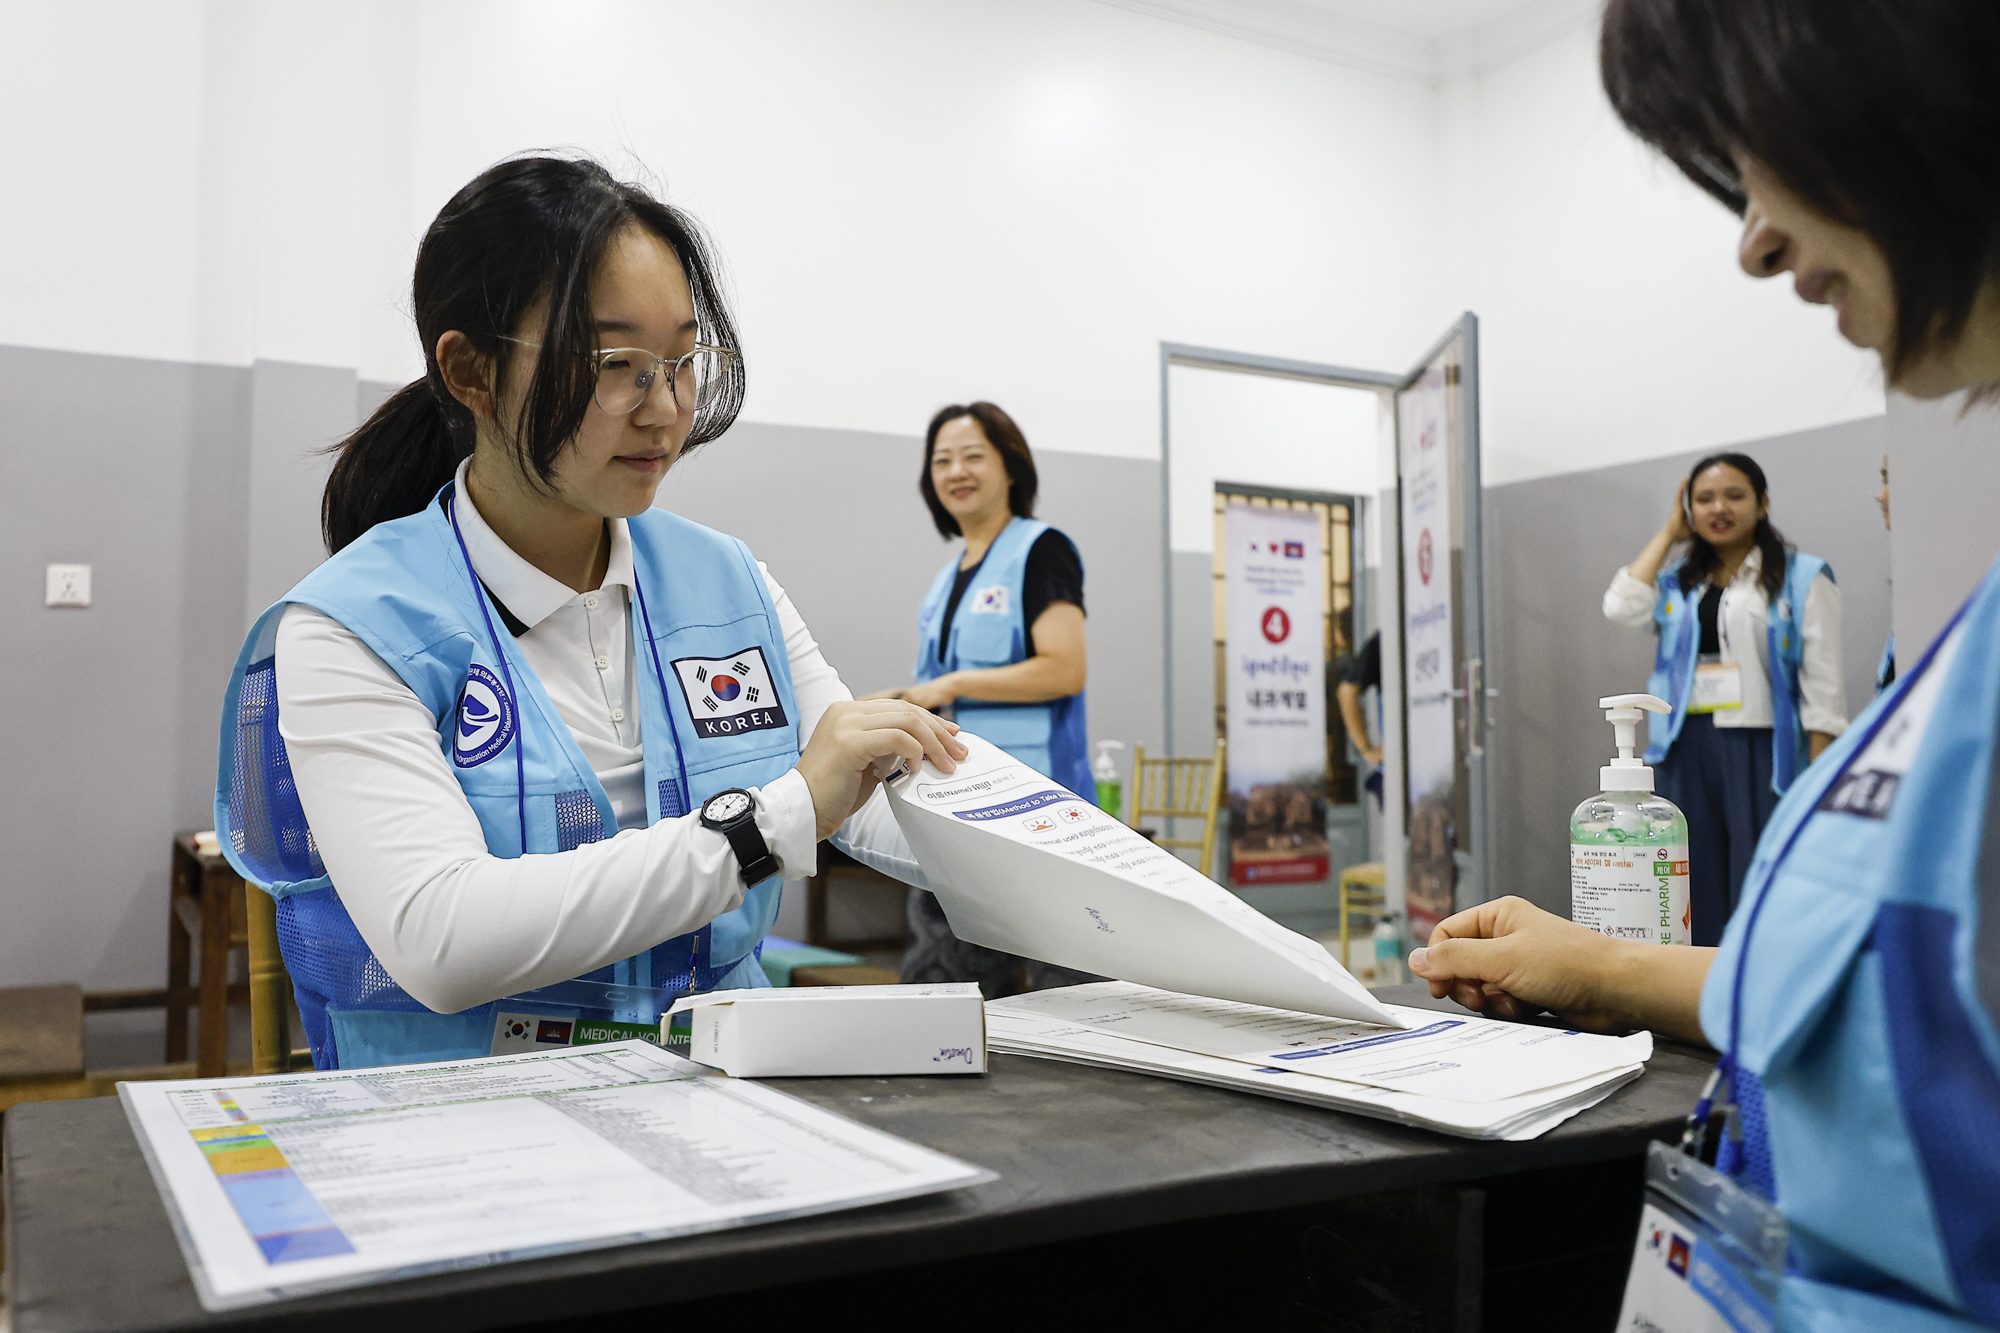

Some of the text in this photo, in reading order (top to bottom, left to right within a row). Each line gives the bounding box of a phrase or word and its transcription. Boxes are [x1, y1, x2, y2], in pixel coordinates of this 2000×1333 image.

[1266, 610, 1283, 640] 4
[705, 711, 774, 733] KOREA
[488, 731, 508, 753] Medical
[927, 786, 972, 800] 이름(Name)
[1031, 796, 1041, 806] to
[1041, 792, 1058, 802] Take
[1659, 878, 1670, 927] PHARM
[580, 1028, 634, 1040] MEDICAL
